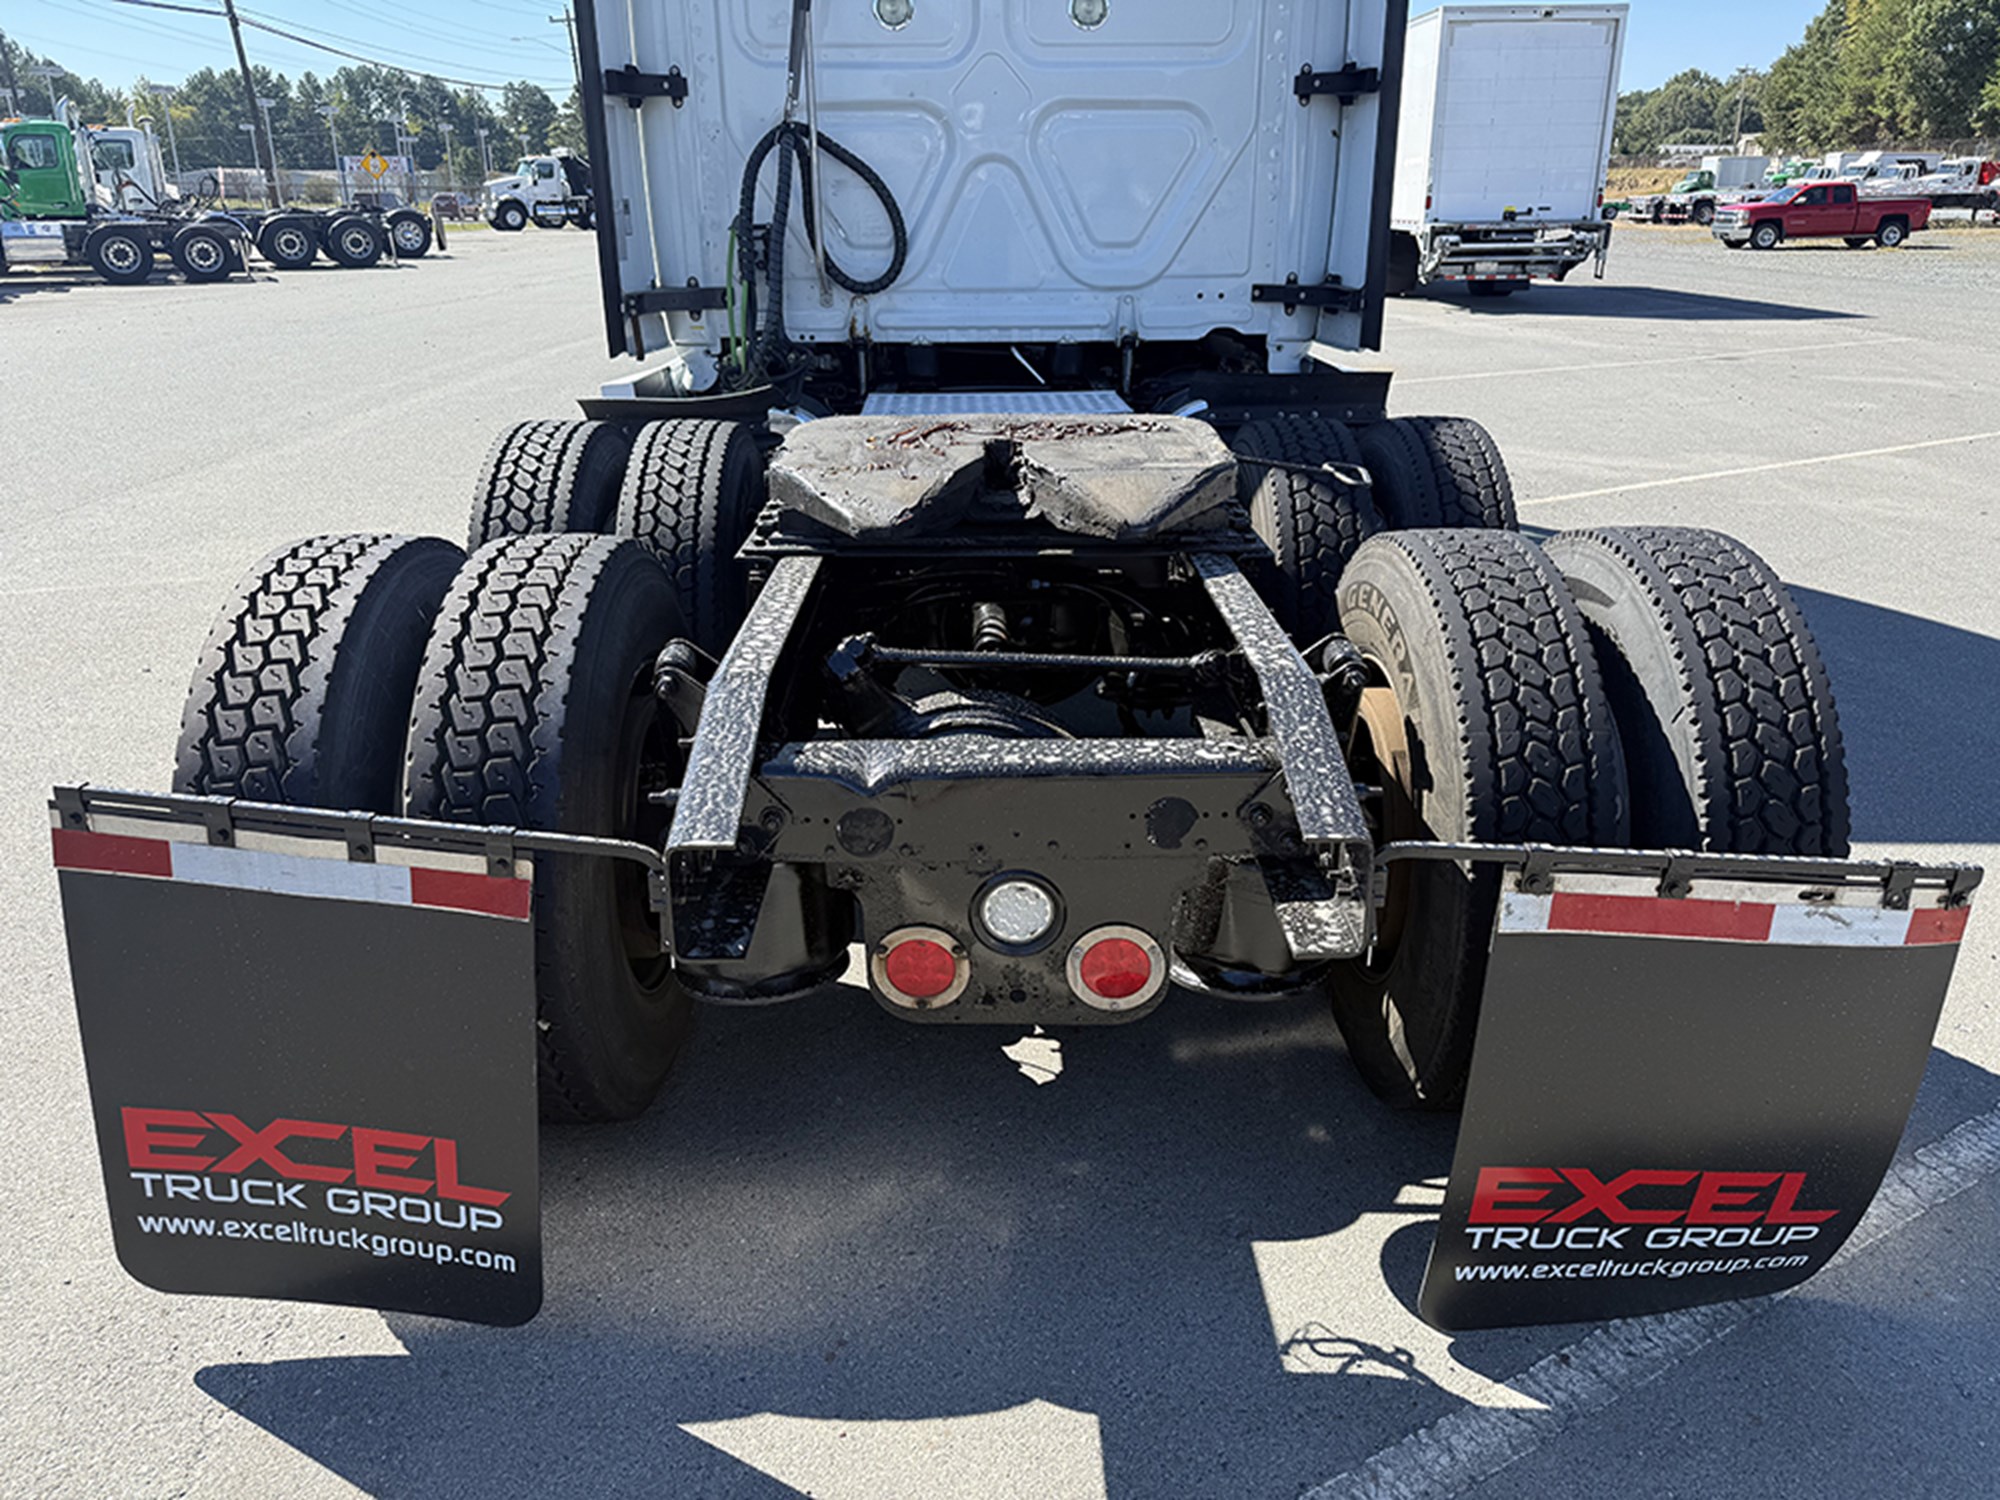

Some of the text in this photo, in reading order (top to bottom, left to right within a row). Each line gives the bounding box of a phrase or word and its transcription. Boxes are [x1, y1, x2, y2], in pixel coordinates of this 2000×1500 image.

[122, 1107, 510, 1206] EXCEL
[130, 1173, 502, 1232] TRUCK GROUP
[1468, 1166, 1840, 1225] EXCEL
[137, 1215, 517, 1273] www.exceltruckgroup.com
[1464, 1227, 1820, 1250] TRUCK GROUP
[1455, 1255, 1809, 1281] www.exceltruckgroup.com
